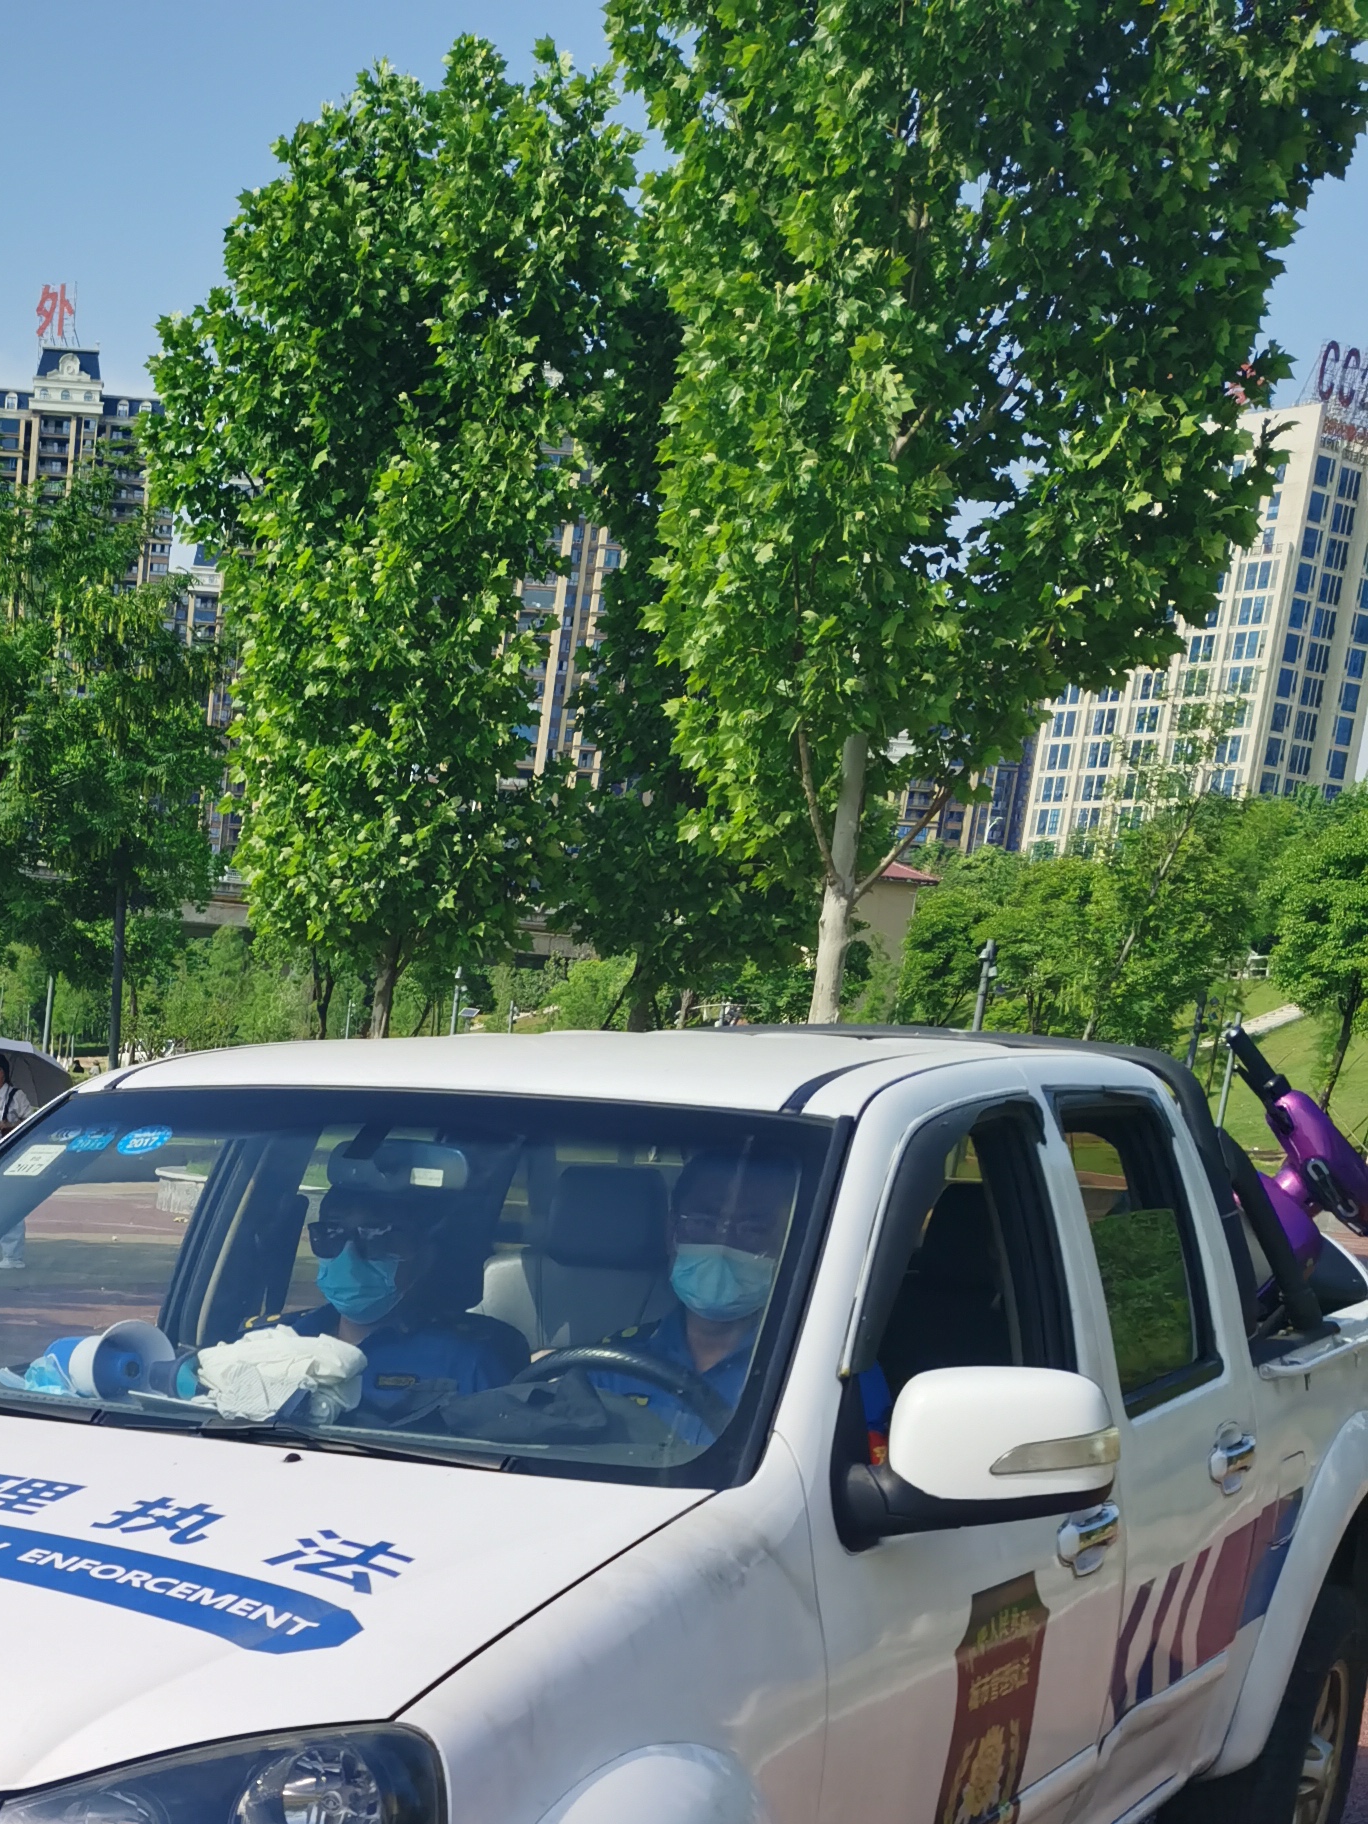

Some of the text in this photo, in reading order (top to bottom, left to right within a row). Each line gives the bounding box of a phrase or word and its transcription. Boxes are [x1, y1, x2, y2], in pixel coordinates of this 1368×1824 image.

[36, 283, 75, 337] 外
[125, 1135, 159, 1149] 2017
[16, 1547, 320, 1637] ENFORCEMENT
